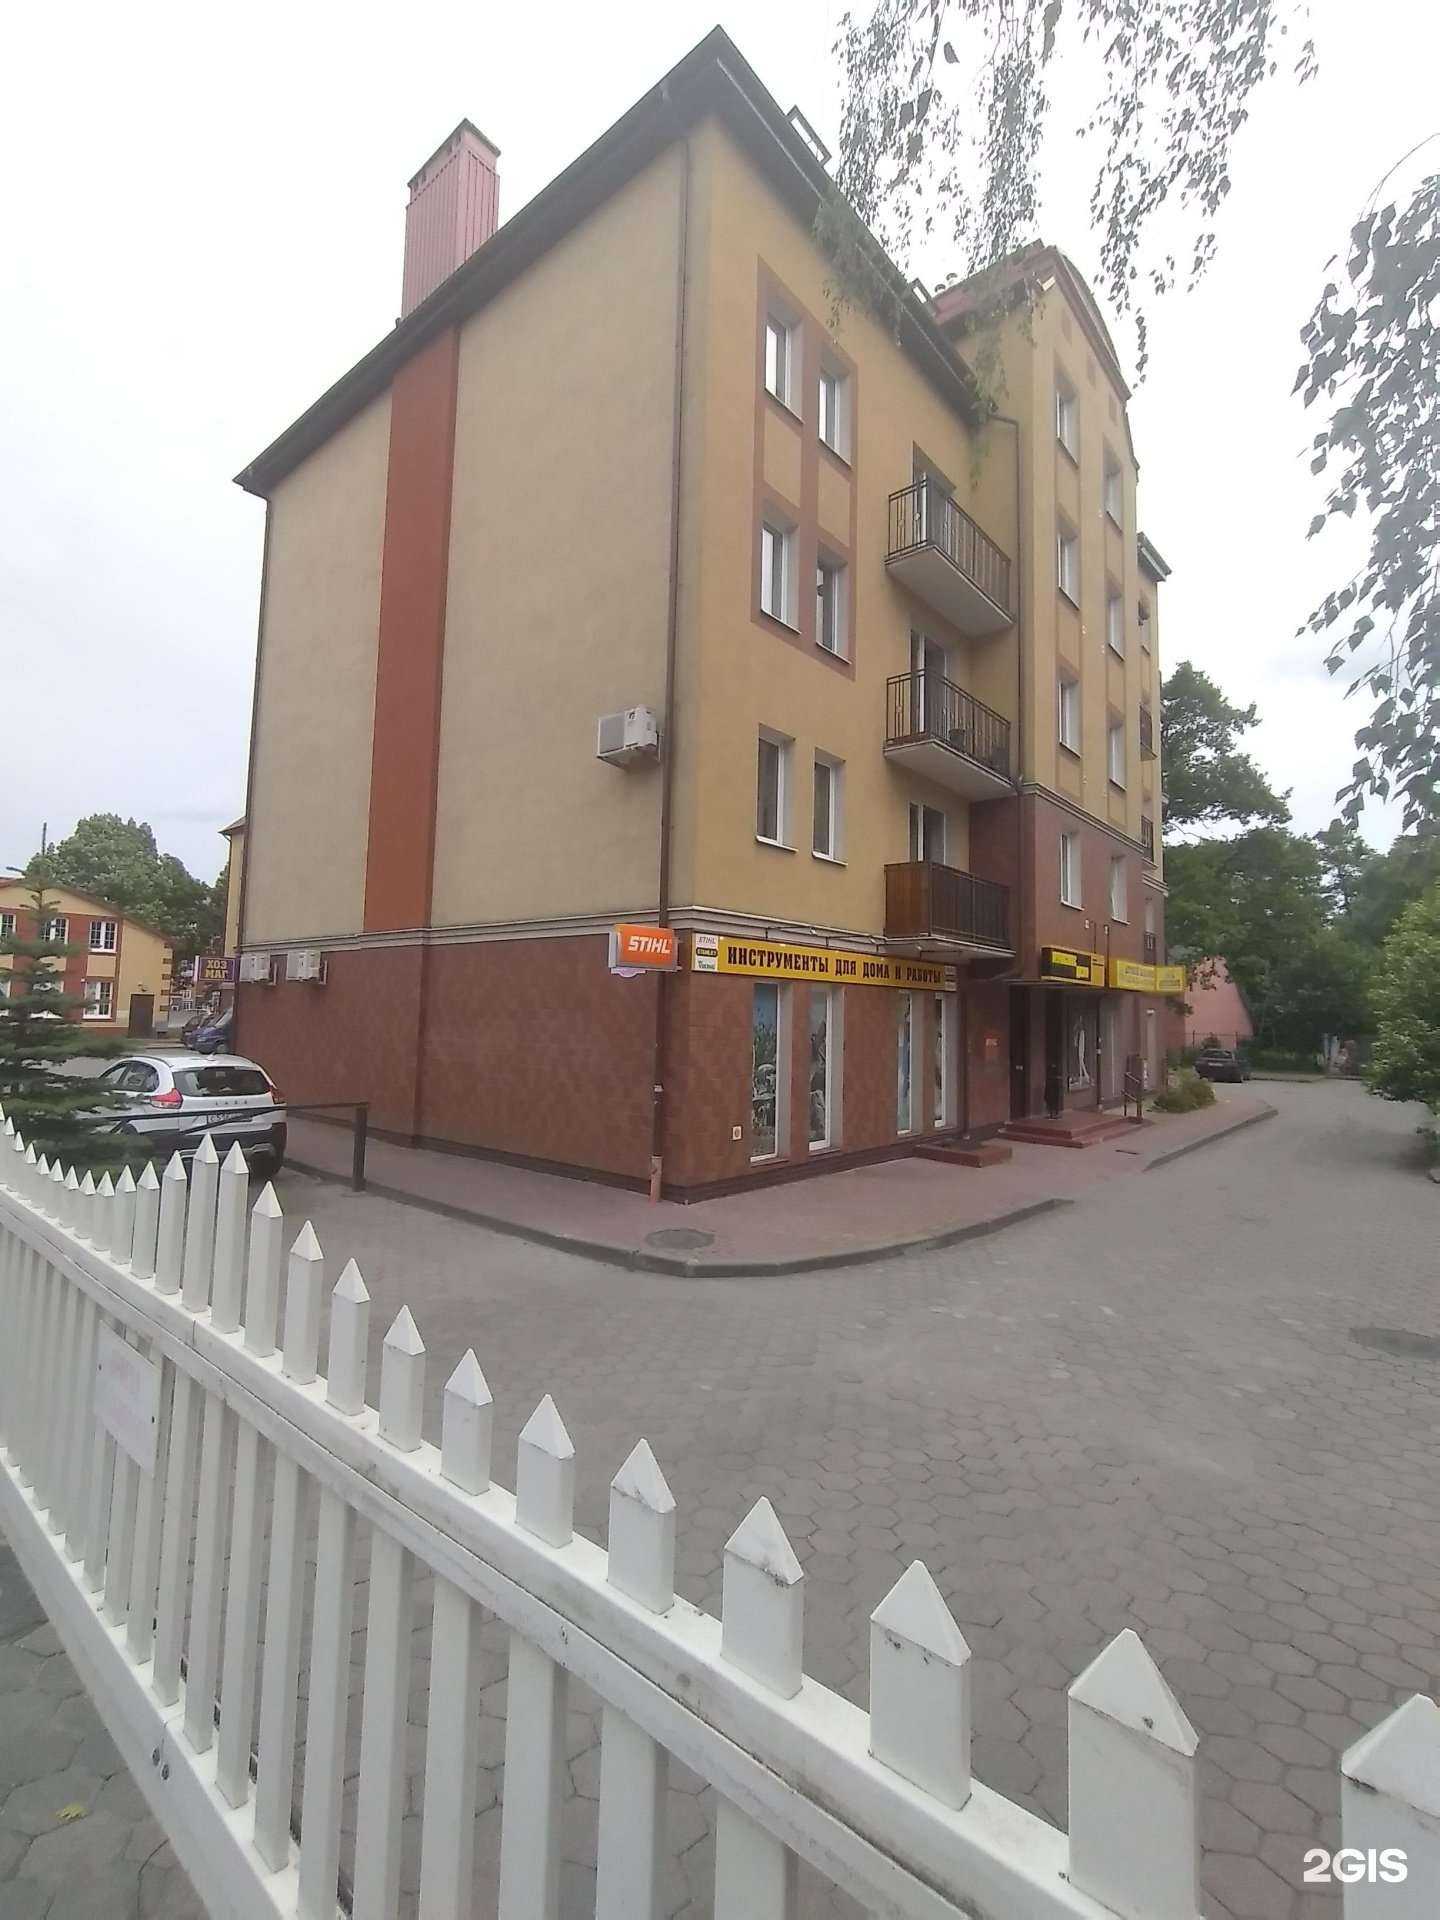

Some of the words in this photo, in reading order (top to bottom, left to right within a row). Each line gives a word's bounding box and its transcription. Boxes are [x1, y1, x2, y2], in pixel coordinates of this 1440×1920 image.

[628, 935, 671, 954] STIHL
[698, 936, 716, 945] STIHL
[206, 960, 228, 969] ХОЗ
[727, 946, 829, 973] ИНСТРУМЕНТЫ
[835, 959, 857, 977] ДЛЯ
[862, 961, 890, 980] ДОМА
[895, 965, 902, 980] И
[906, 967, 941, 984] РАБОТЫ
[205, 969, 229, 979] МАГ
